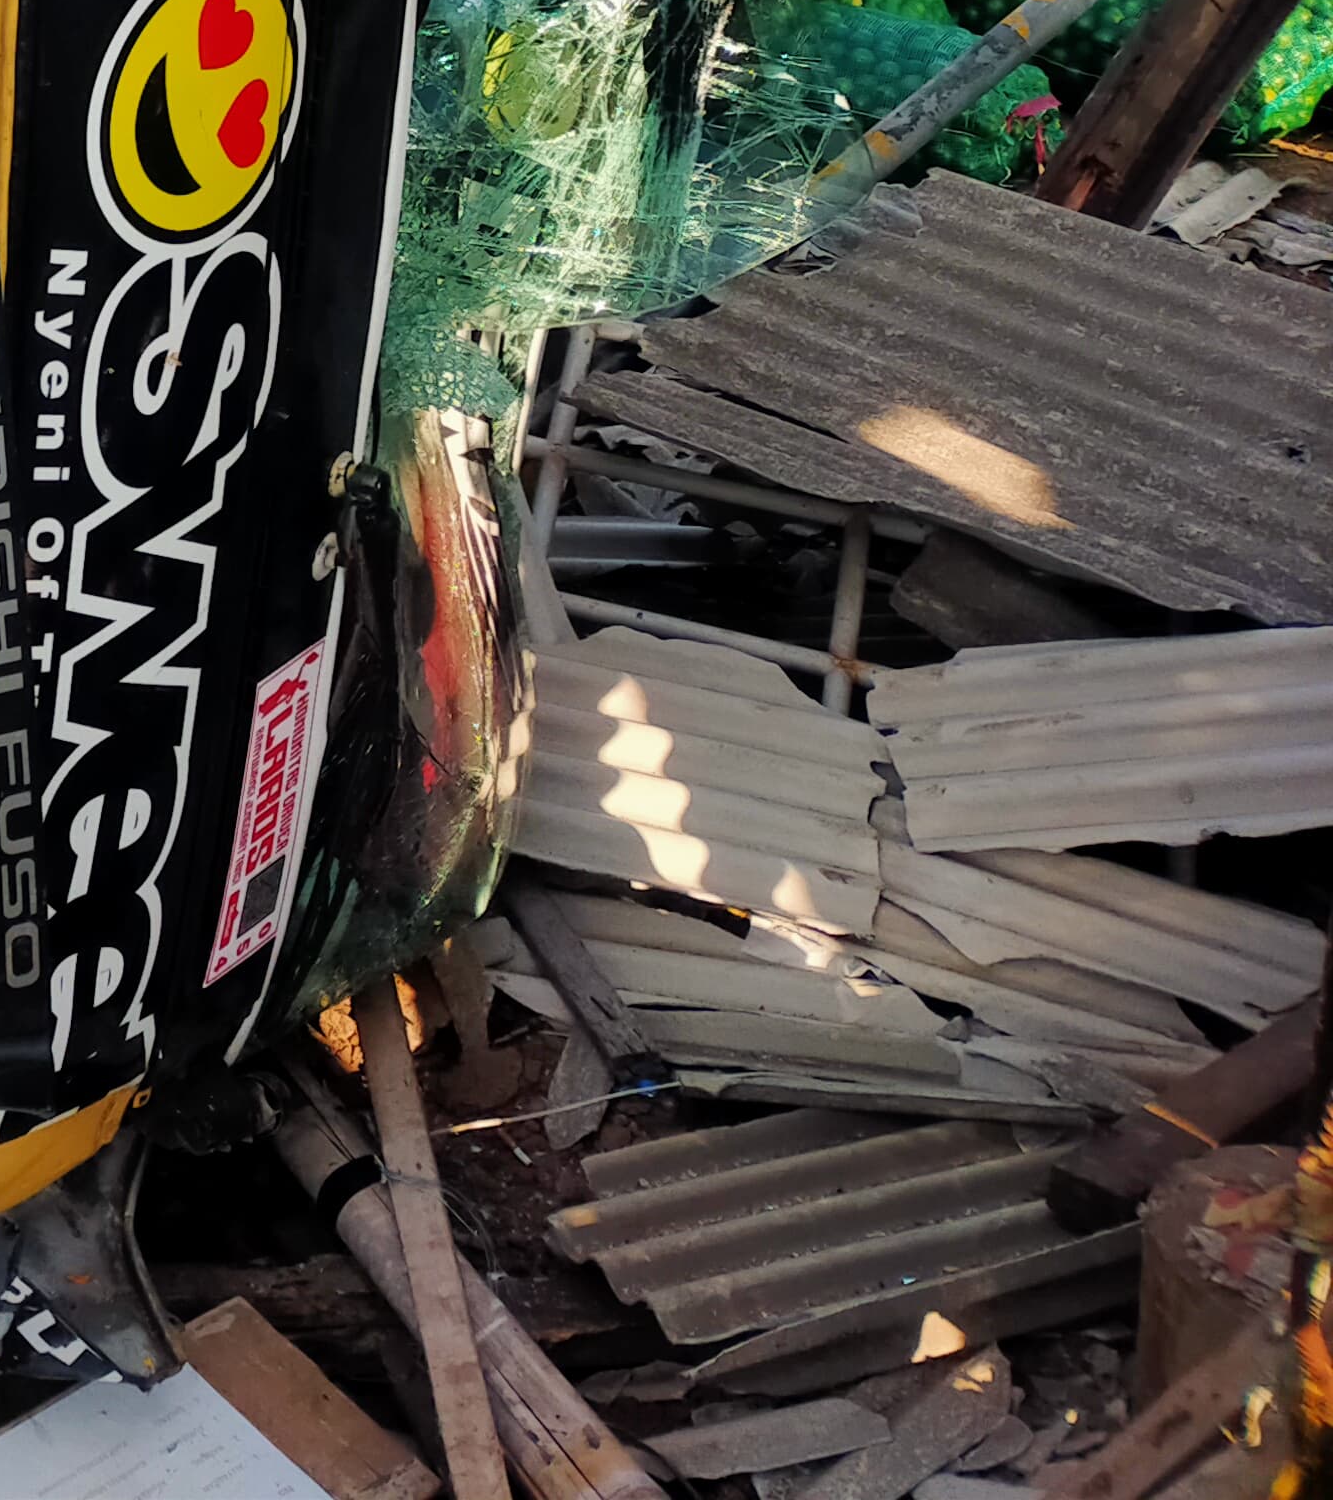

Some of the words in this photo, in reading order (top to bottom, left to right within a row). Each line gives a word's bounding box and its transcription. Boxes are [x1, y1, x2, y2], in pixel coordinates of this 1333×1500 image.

[33, 247, 89, 482] Nyeni
[25, 516, 66, 601] Of
[244, 704, 294, 877] LAROS
